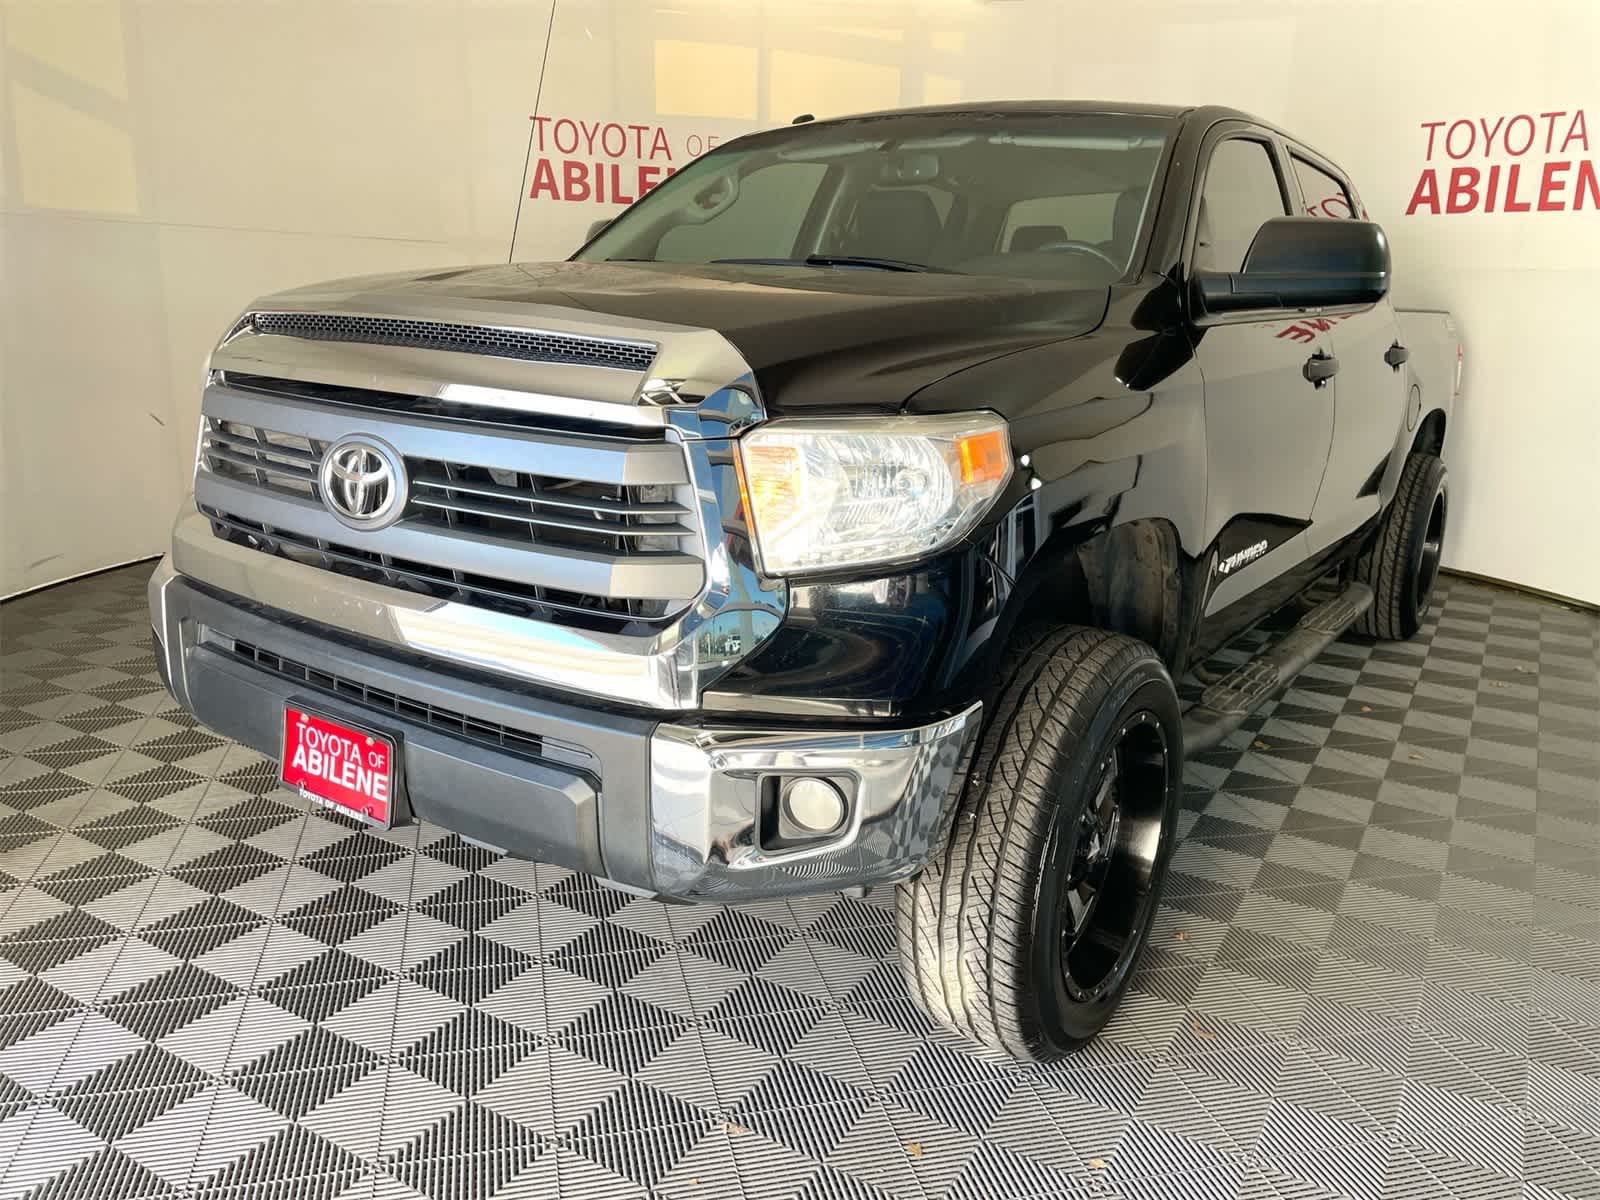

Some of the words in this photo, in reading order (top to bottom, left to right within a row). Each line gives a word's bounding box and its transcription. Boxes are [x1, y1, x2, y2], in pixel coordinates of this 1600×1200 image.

[529, 115, 673, 161] TOYOTA
[1420, 109, 1590, 161] TOYOTA
[529, 157, 676, 206] ABILE
[296, 722, 362, 766] TOYOTA
[368, 751, 385, 769] OF
[291, 743, 388, 801] ABILENE
